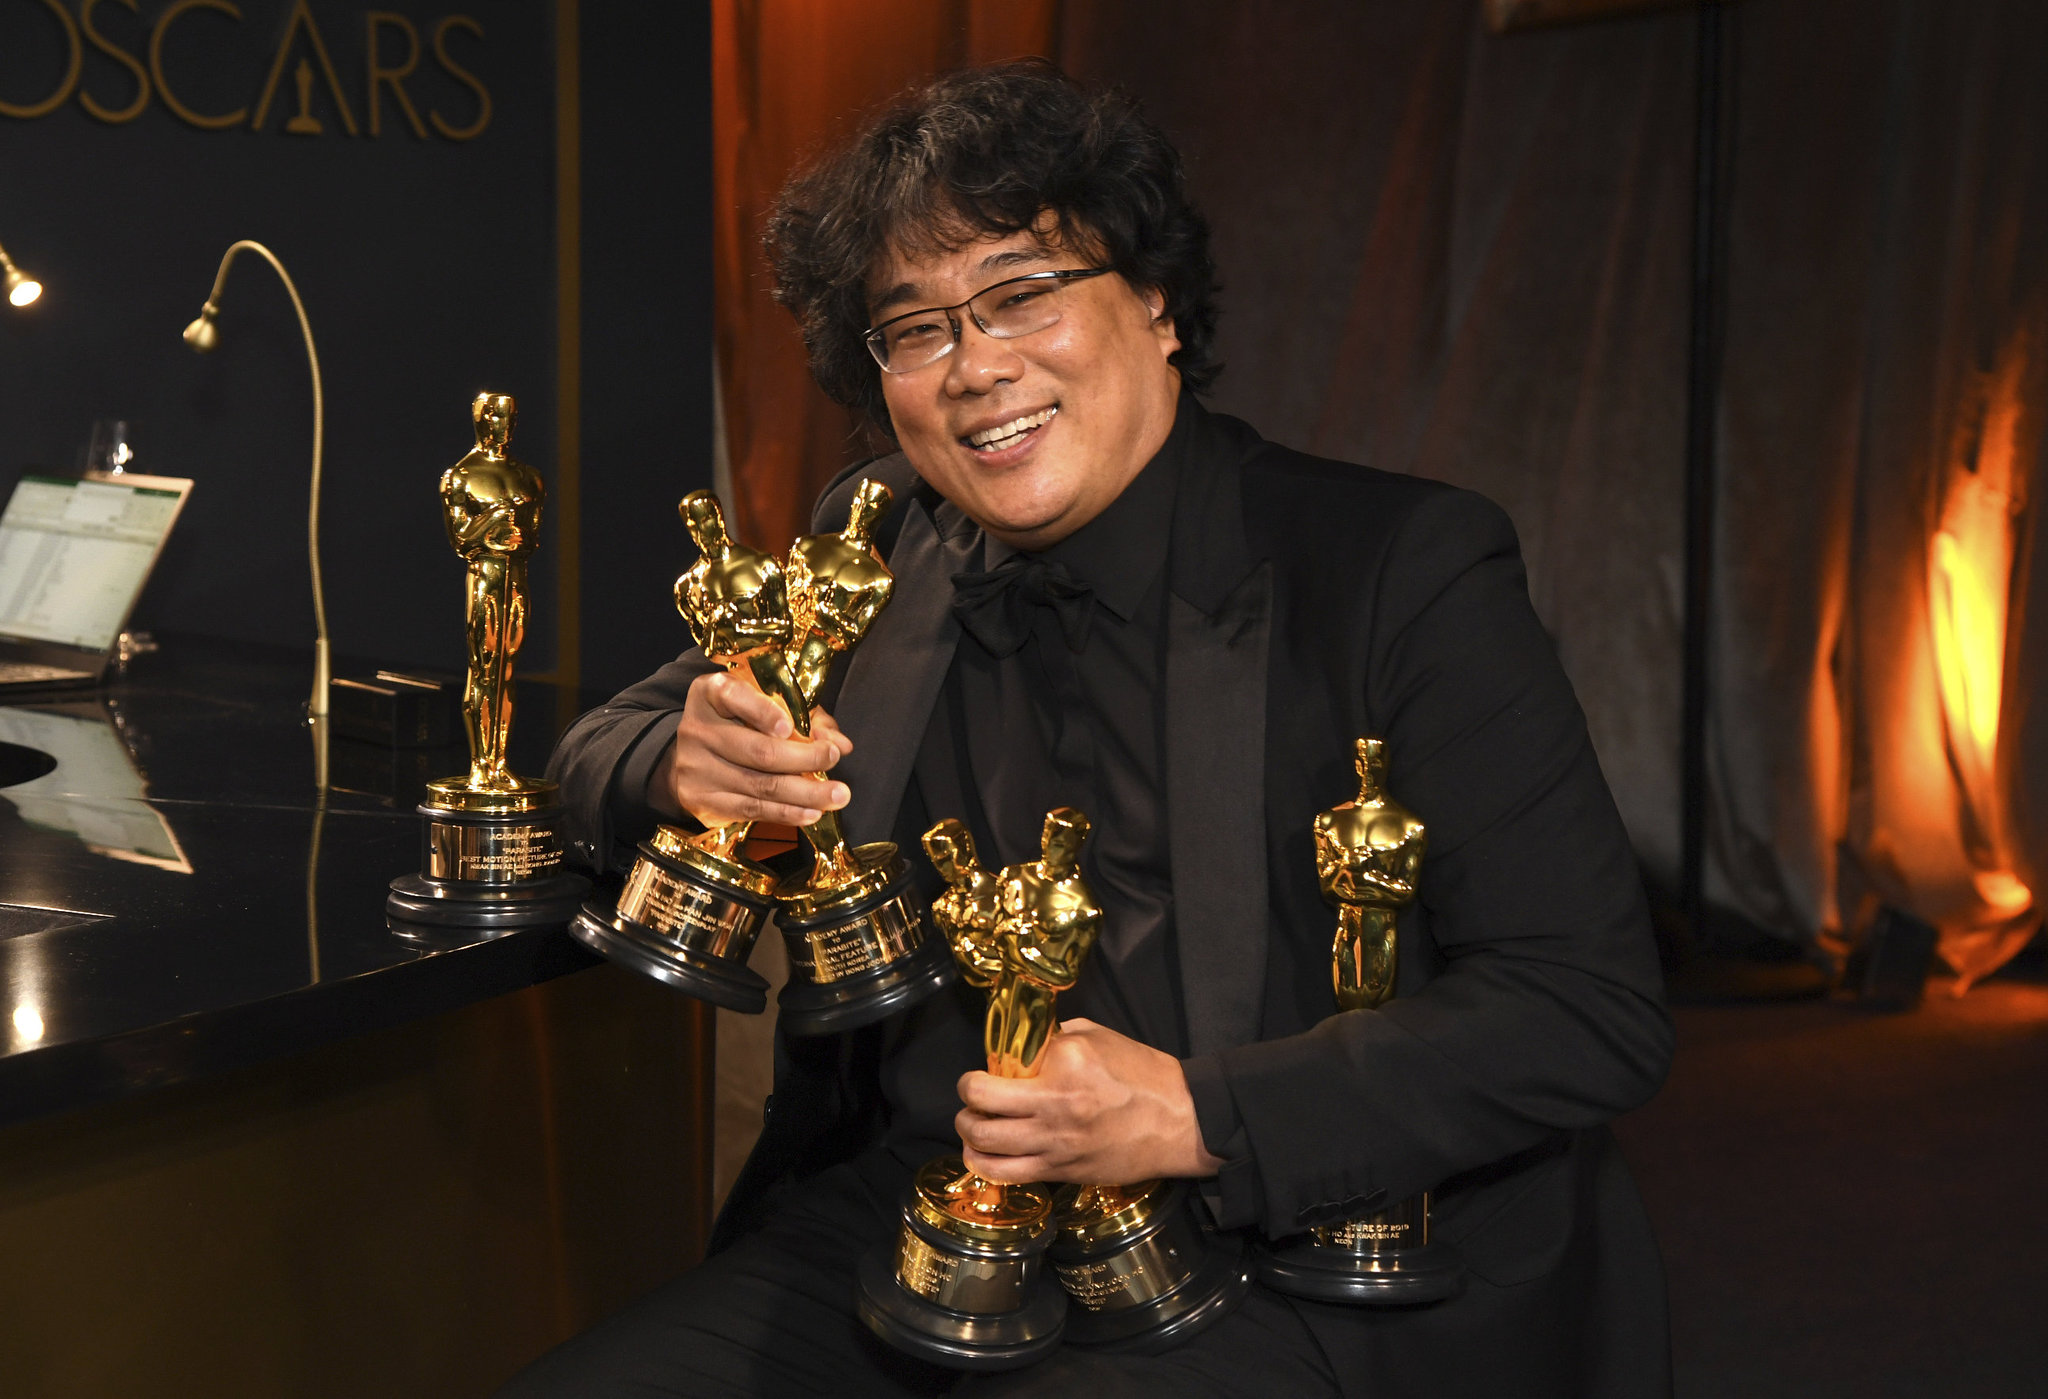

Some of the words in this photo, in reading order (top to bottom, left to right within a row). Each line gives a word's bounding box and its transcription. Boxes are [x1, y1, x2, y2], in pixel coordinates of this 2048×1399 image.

[0, 0, 492, 139] OSCARS
[686, 888, 713, 904] AWARD
[685, 906, 701, 918] HAN
[839, 919, 868, 933] AWARD
[840, 941, 878, 960] FEATURE
[847, 956, 870, 966] KOREA
[1376, 1224, 1388, 1232] OF
[928, 1252, 959, 1268] AWARD
